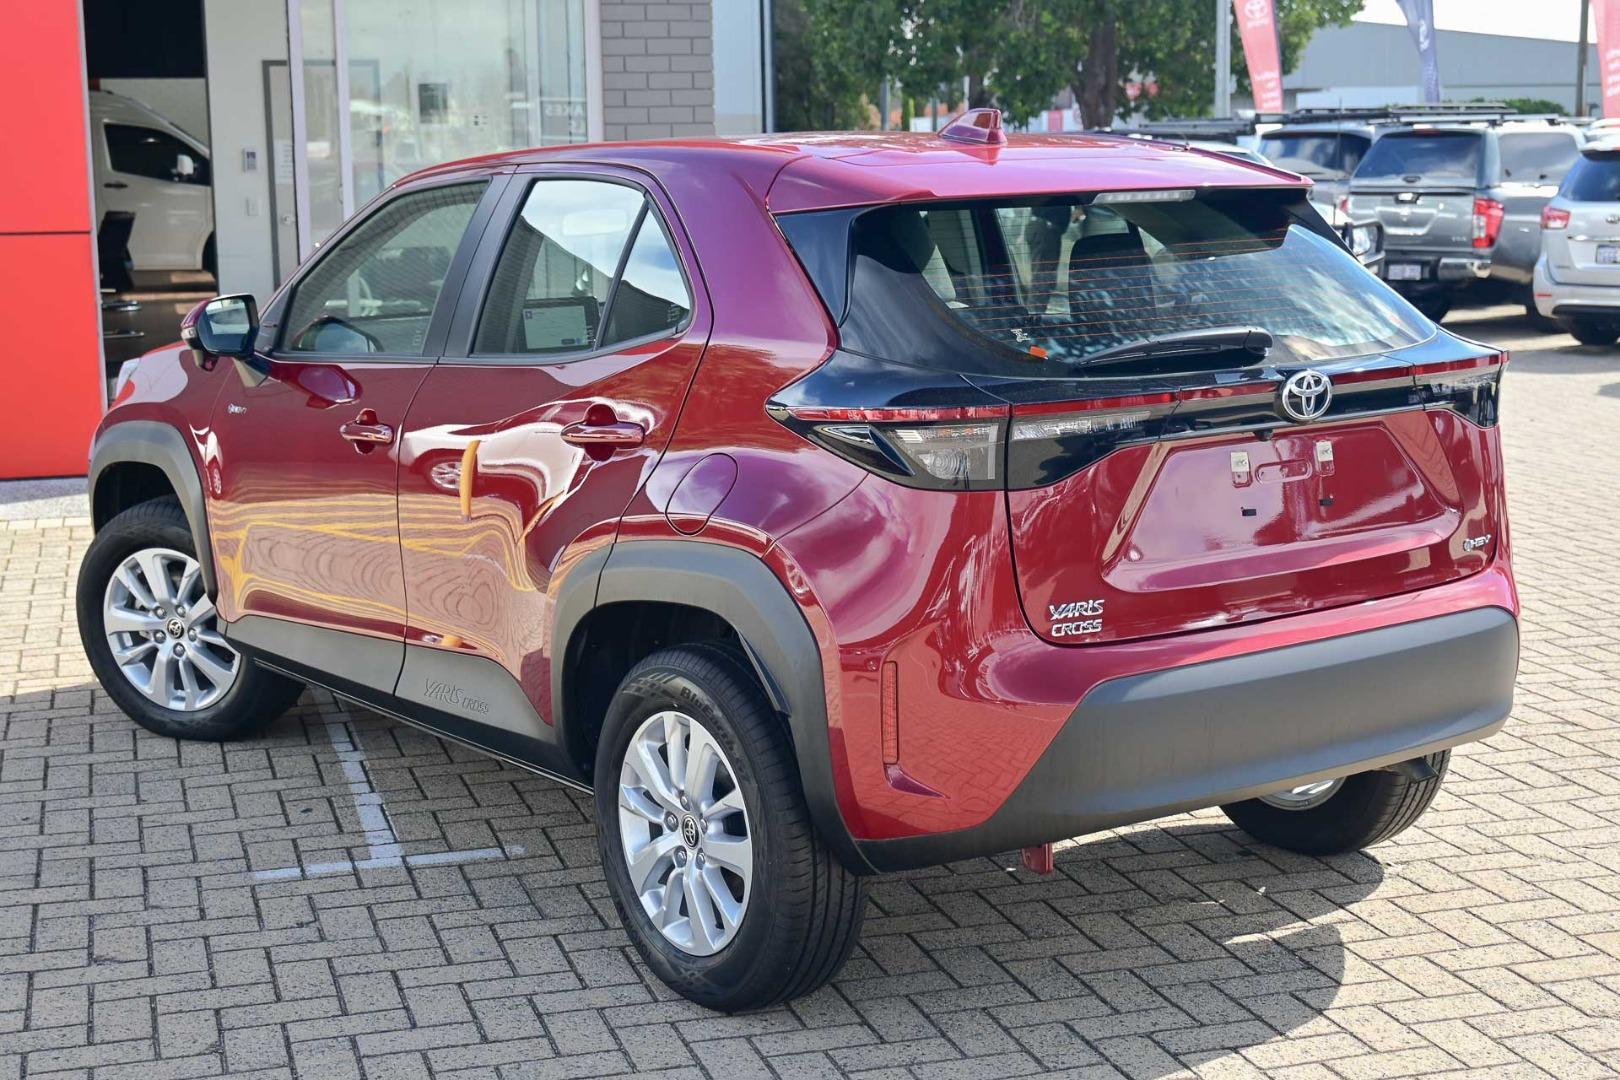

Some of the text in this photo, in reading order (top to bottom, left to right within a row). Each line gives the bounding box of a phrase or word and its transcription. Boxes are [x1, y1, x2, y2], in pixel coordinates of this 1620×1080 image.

[1049, 599, 1105, 620] YARIS
[1051, 619, 1103, 637] CROSS
[424, 679, 489, 714] YARIS CROSS
